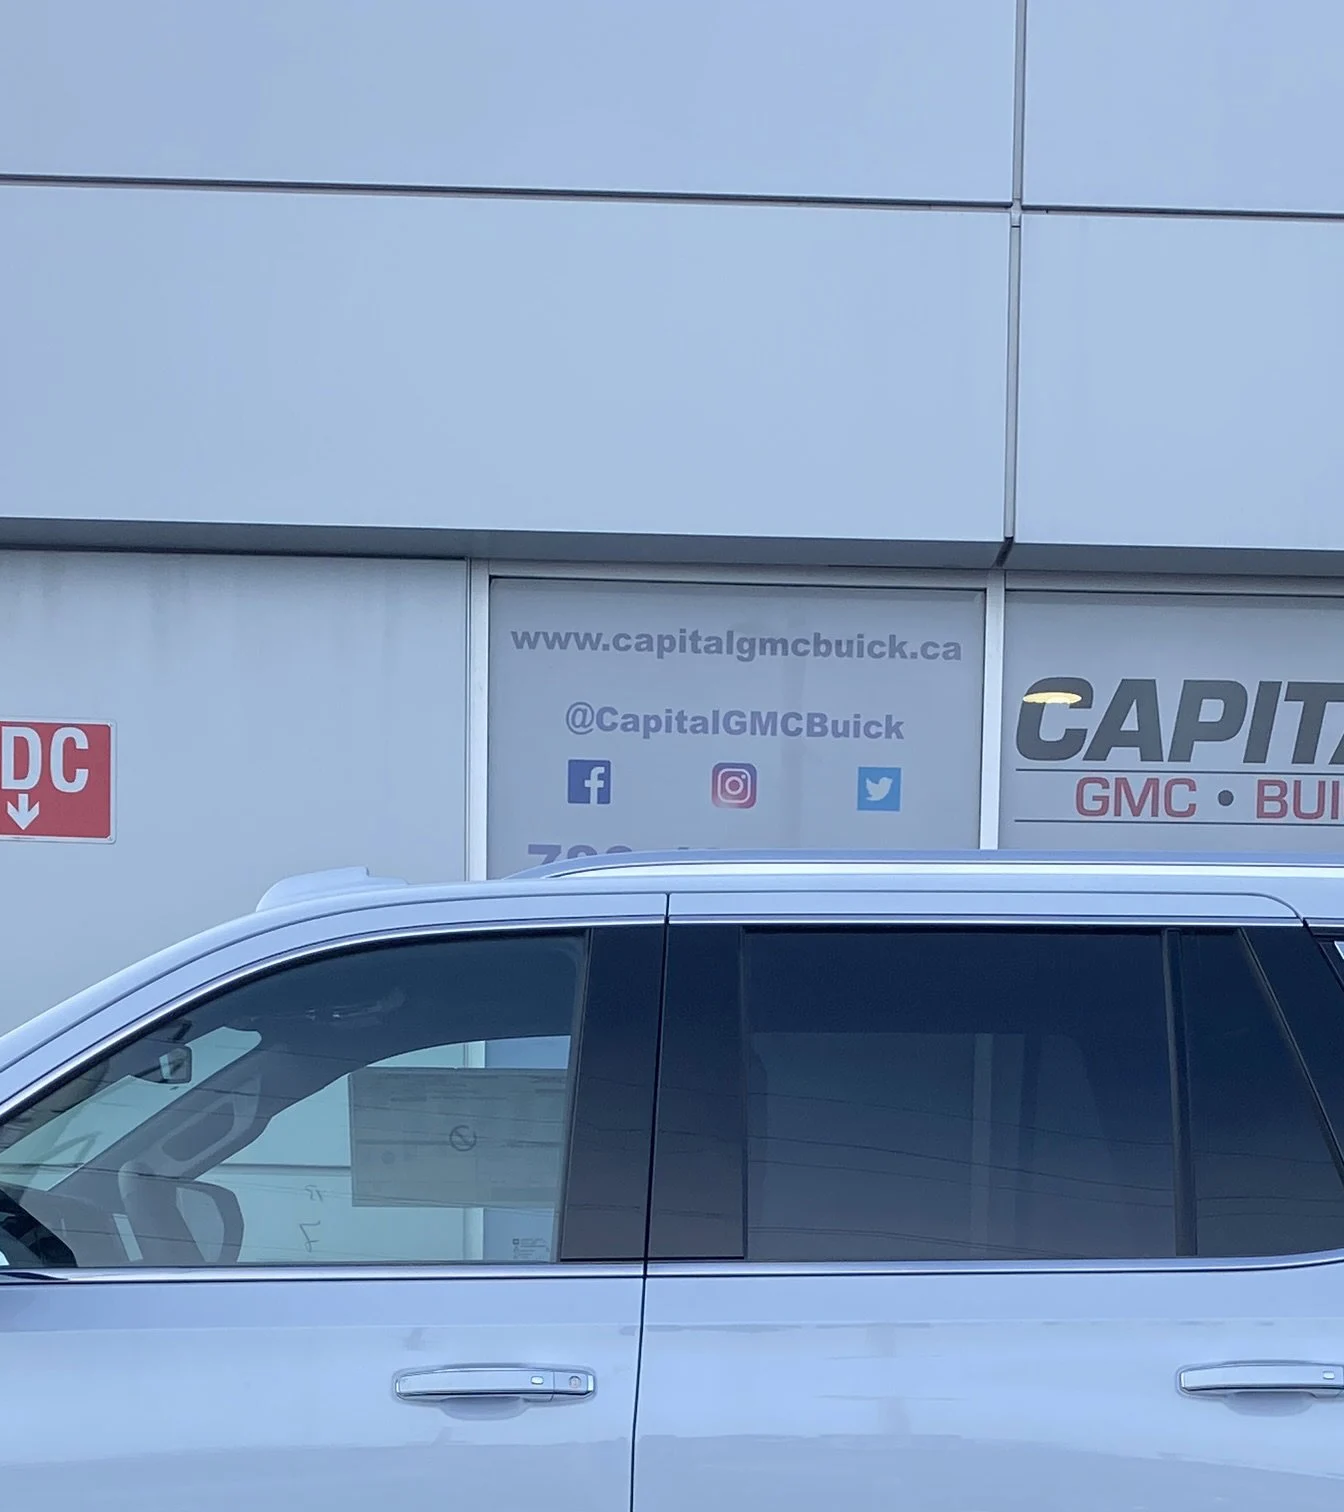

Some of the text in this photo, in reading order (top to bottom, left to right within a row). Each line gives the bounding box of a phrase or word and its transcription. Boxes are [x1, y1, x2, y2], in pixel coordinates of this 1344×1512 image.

[511, 628, 962, 662] www.capitalgmcbuick.ca
[565, 701, 905, 740] @CapitalGMCBuick
[1075, 776, 1197, 818] GMC
